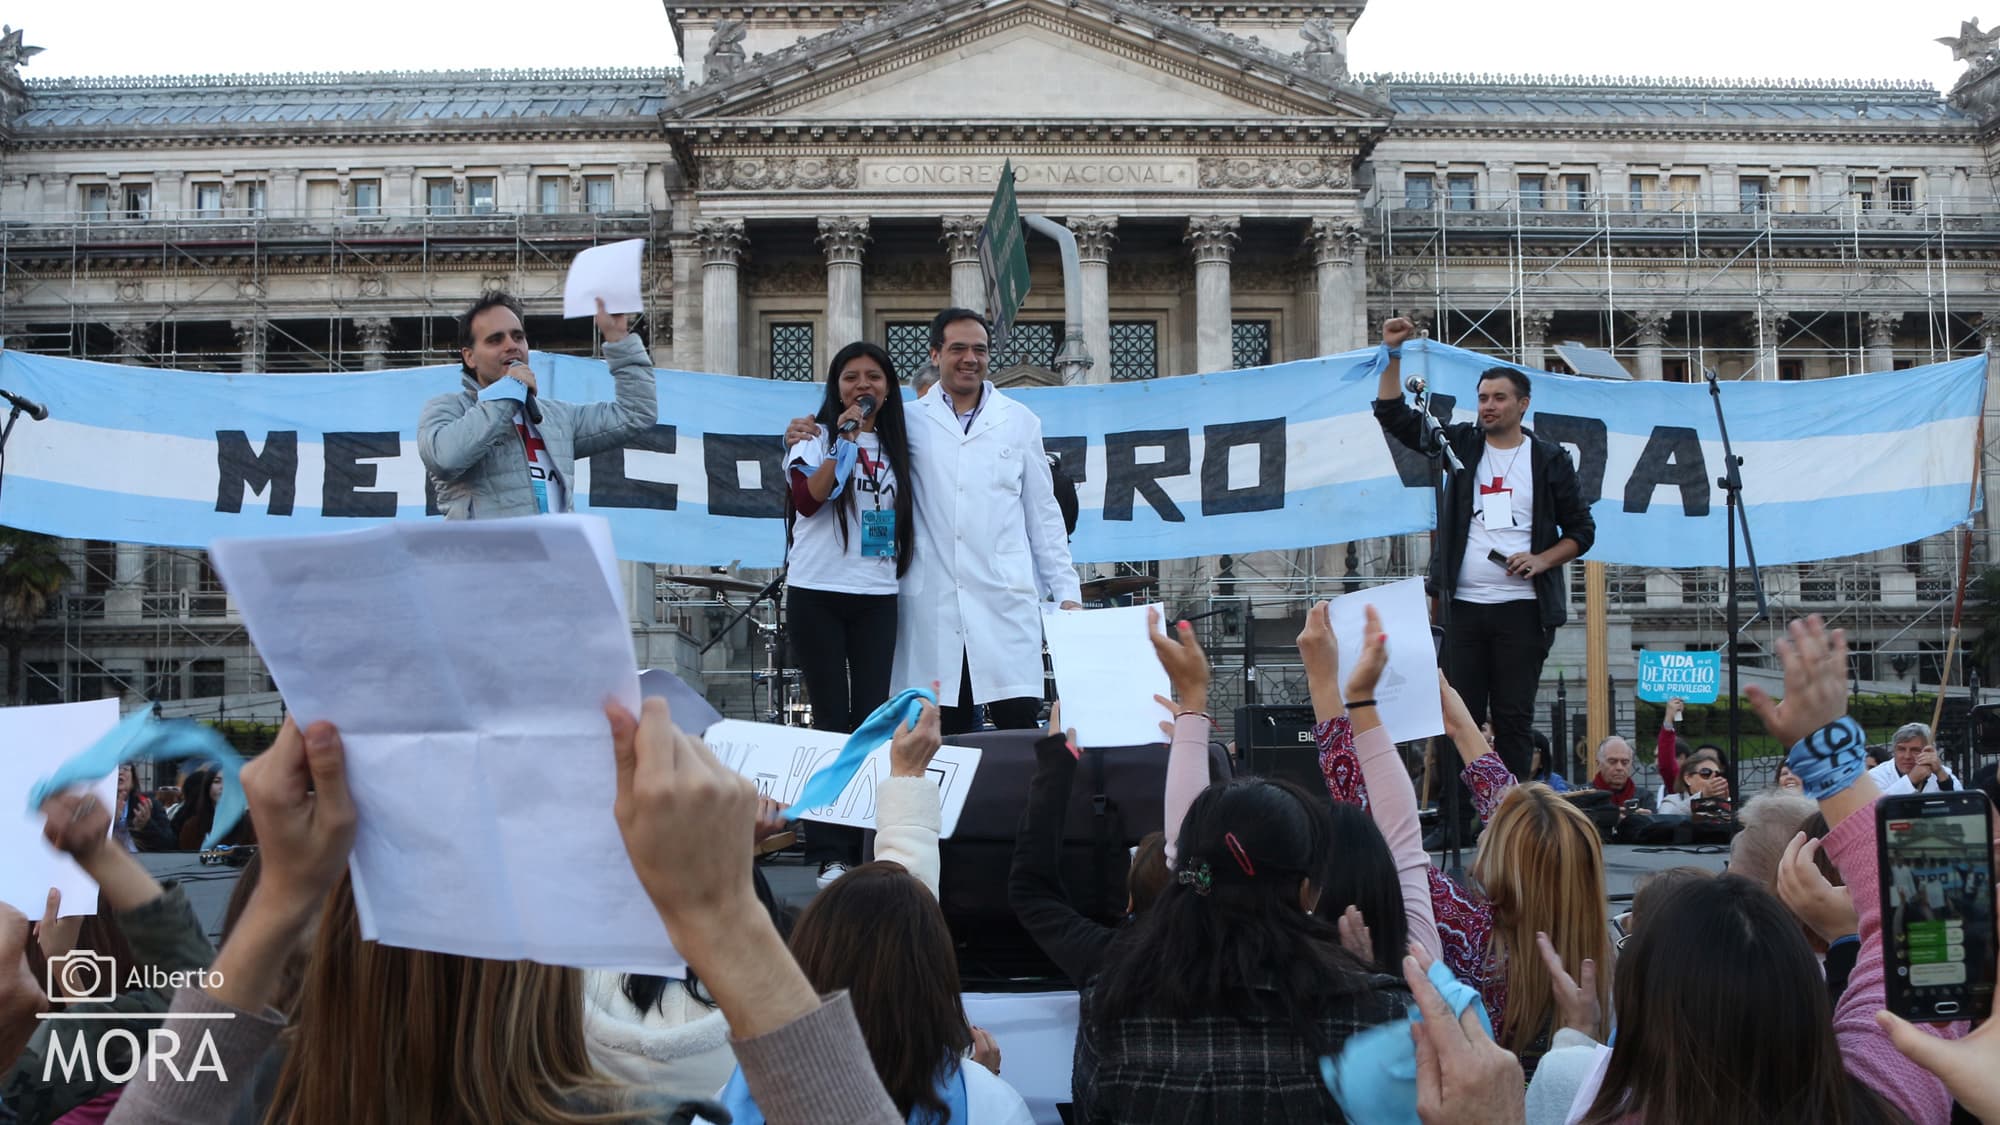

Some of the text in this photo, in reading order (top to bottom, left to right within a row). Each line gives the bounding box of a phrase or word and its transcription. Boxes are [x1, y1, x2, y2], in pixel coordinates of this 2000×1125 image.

[1047, 165, 1173, 184] NACIONAL
[1371, 392, 1711, 517] VDA
[1660, 654, 1695, 667] VIDA
[1653, 683, 1664, 692] UN
